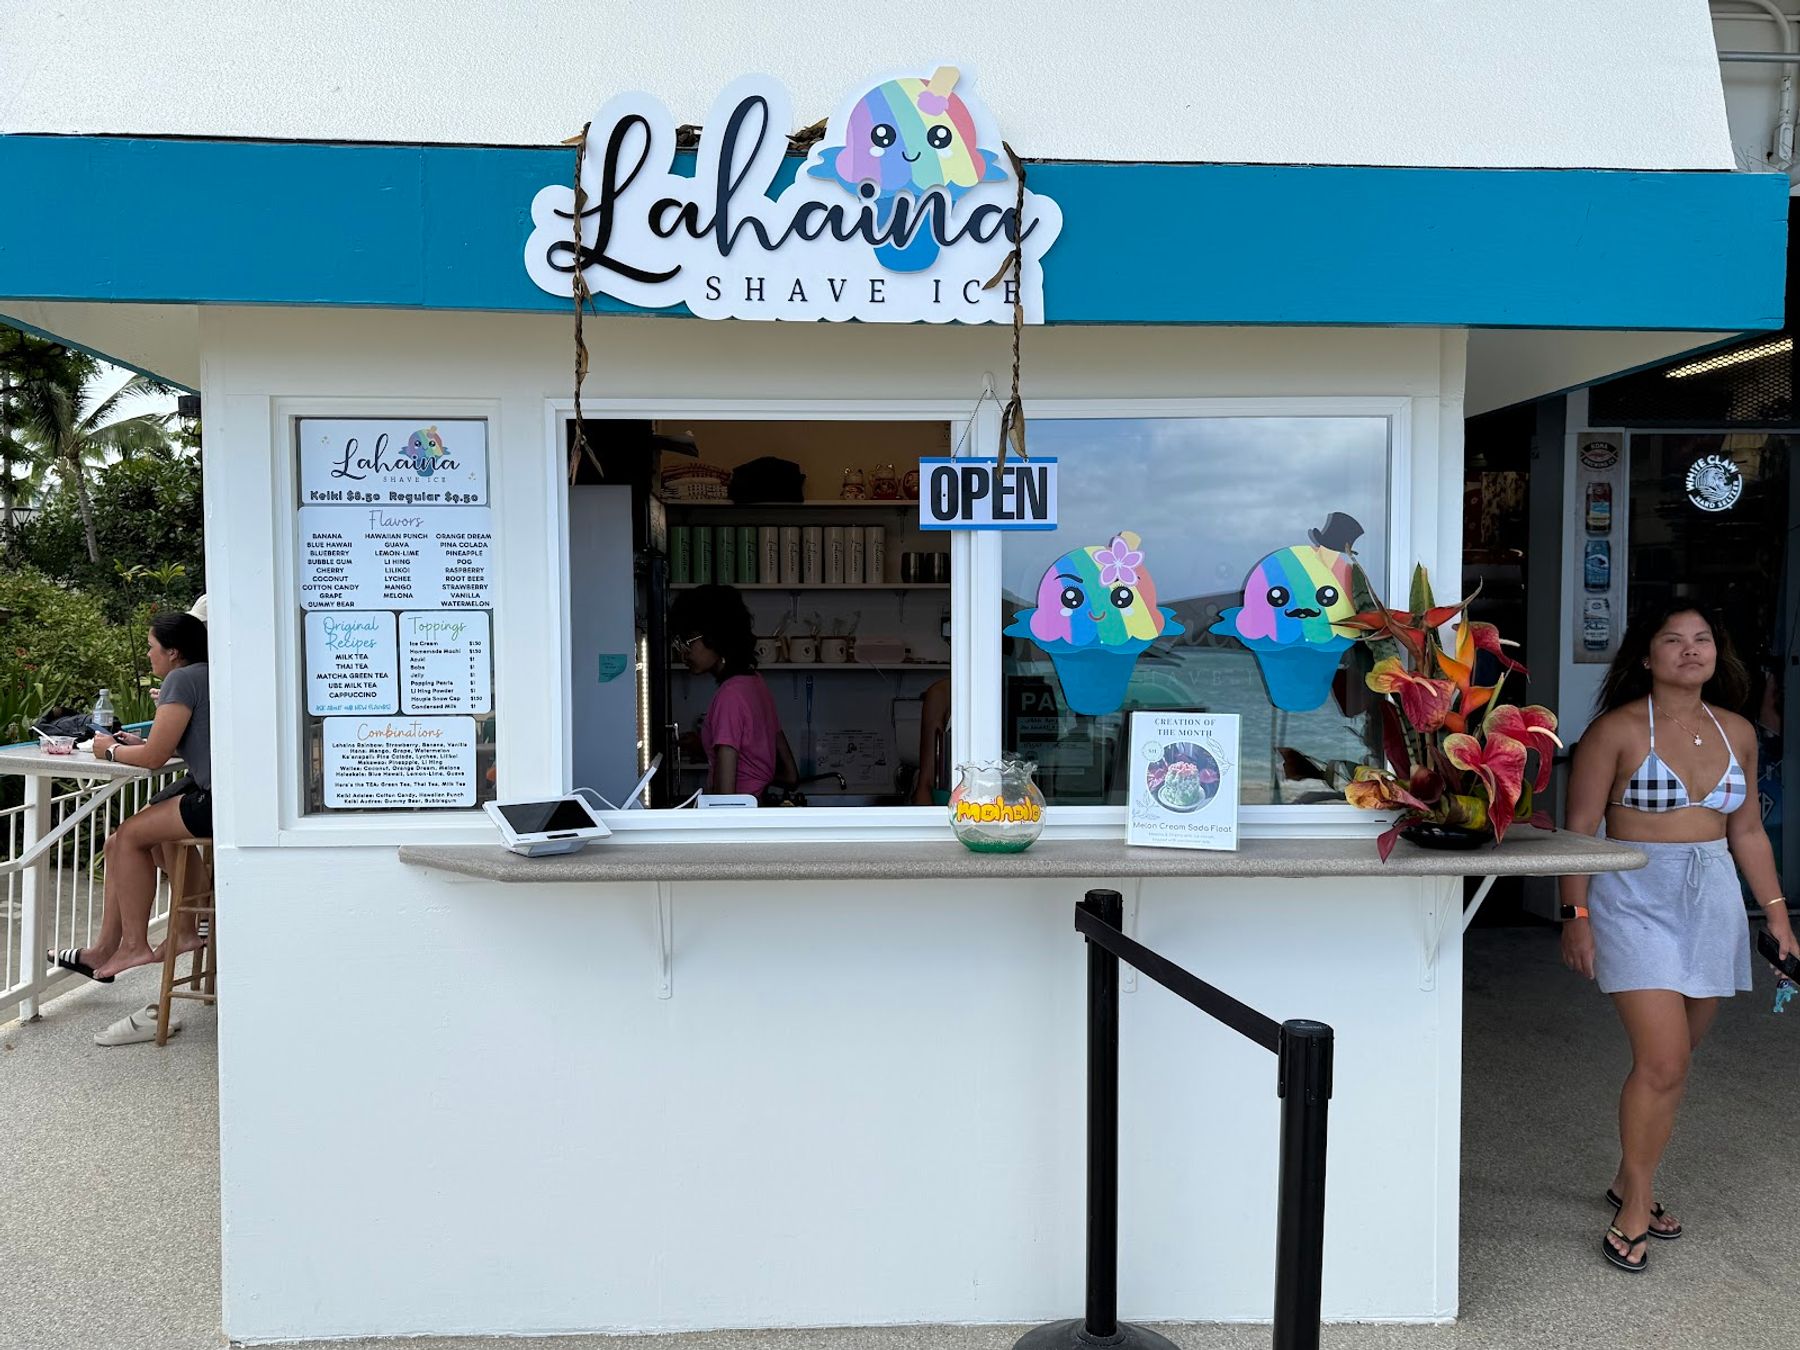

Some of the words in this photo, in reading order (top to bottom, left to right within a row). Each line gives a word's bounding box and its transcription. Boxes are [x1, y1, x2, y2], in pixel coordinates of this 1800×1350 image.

[547, 95, 1039, 283] Lahaina
[706, 276, 886, 303] SHAVE
[933, 279, 1021, 307] ICE
[331, 433, 460, 480] Lahaina
[1685, 458, 1707, 492] WHITE
[1707, 455, 1739, 473] CLAW
[389, 491, 440, 504] Regular
[930, 466, 1048, 521] OPEN
[1695, 496, 1715, 508] HARD
[1717, 480, 1739, 507] SELTZER
[369, 509, 424, 530] Flavors
[323, 616, 379, 640] Original
[407, 616, 466, 641] Toppings
[357, 720, 443, 742] Combinations
[1158, 729, 1175, 737] THE
[1179, 729, 1212, 737] MONTH
[1159, 823, 1186, 831] Cream
[1188, 823, 1209, 832] Soda
[1210, 824, 1232, 833] Float
